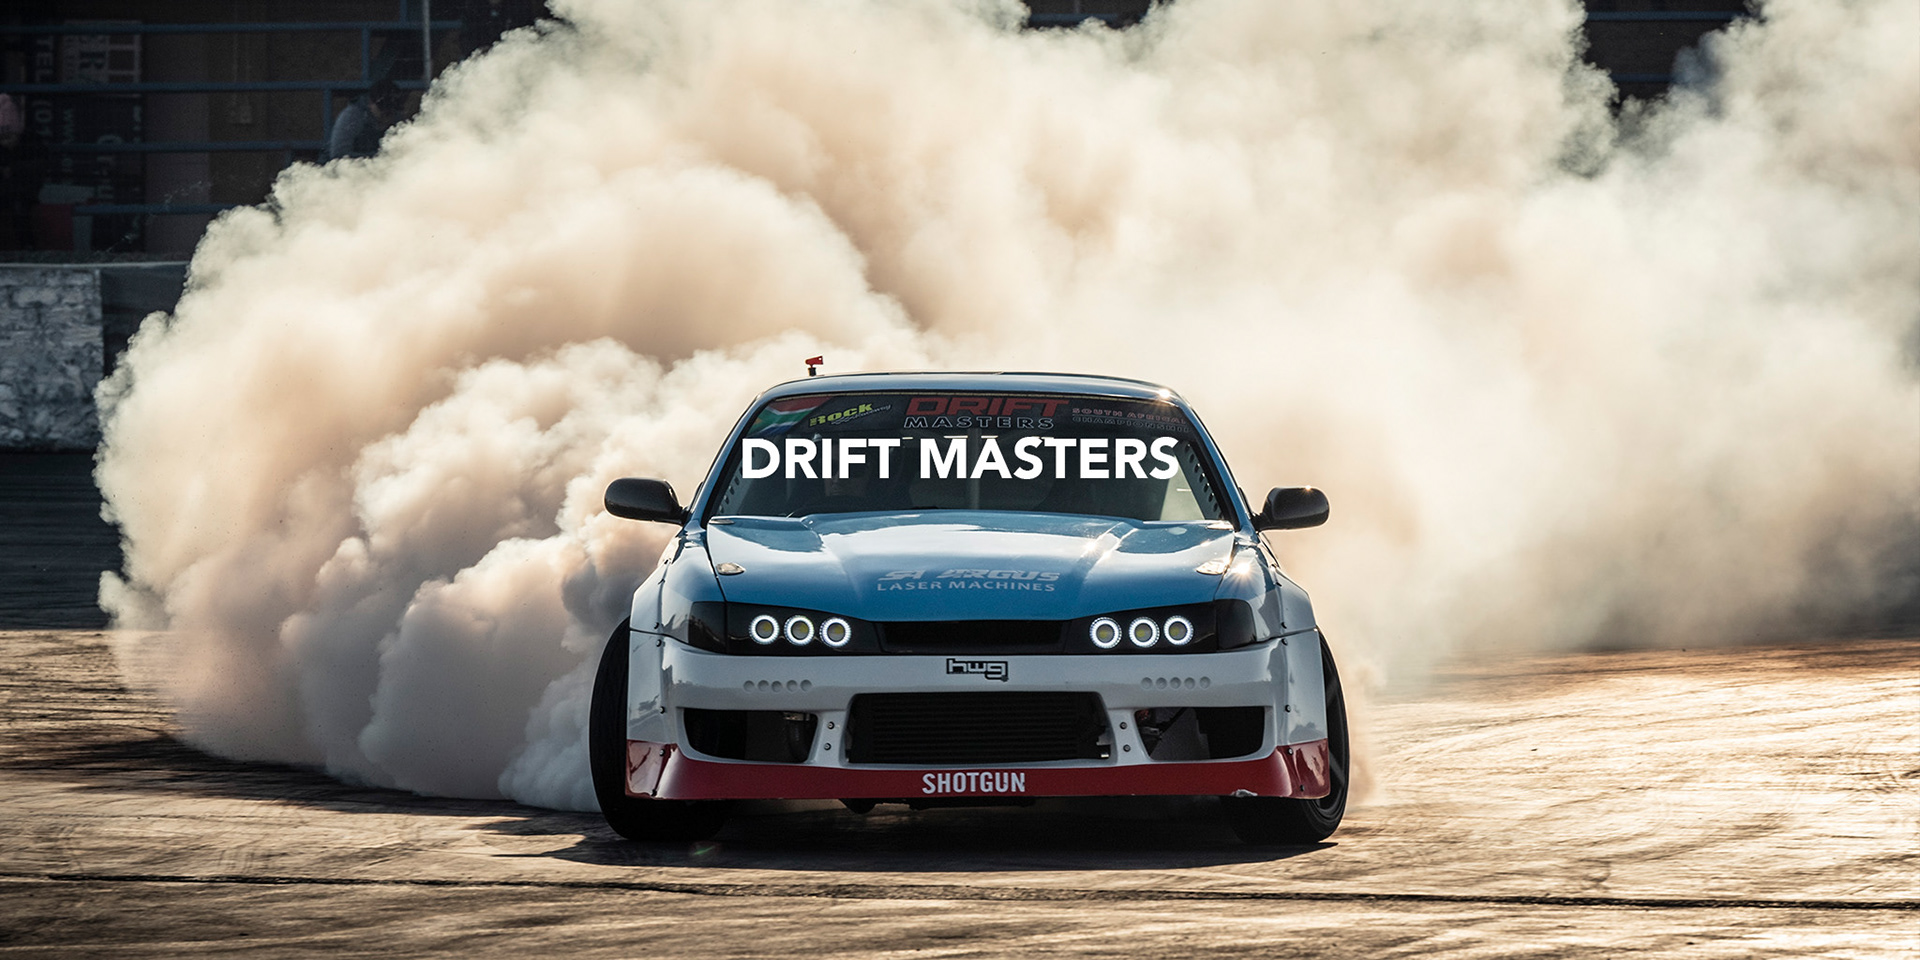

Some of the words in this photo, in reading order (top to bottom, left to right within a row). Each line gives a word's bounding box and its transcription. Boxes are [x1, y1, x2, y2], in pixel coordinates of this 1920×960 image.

[906, 397, 1069, 417] DRIFT
[1072, 408, 1123, 417] SOUTH
[903, 416, 1055, 430] MASTERS
[936, 569, 1061, 582] ARGUS
[877, 581, 942, 591] LASER
[949, 581, 1055, 592] MACHINES
[922, 772, 1026, 795] SHOTGUN
